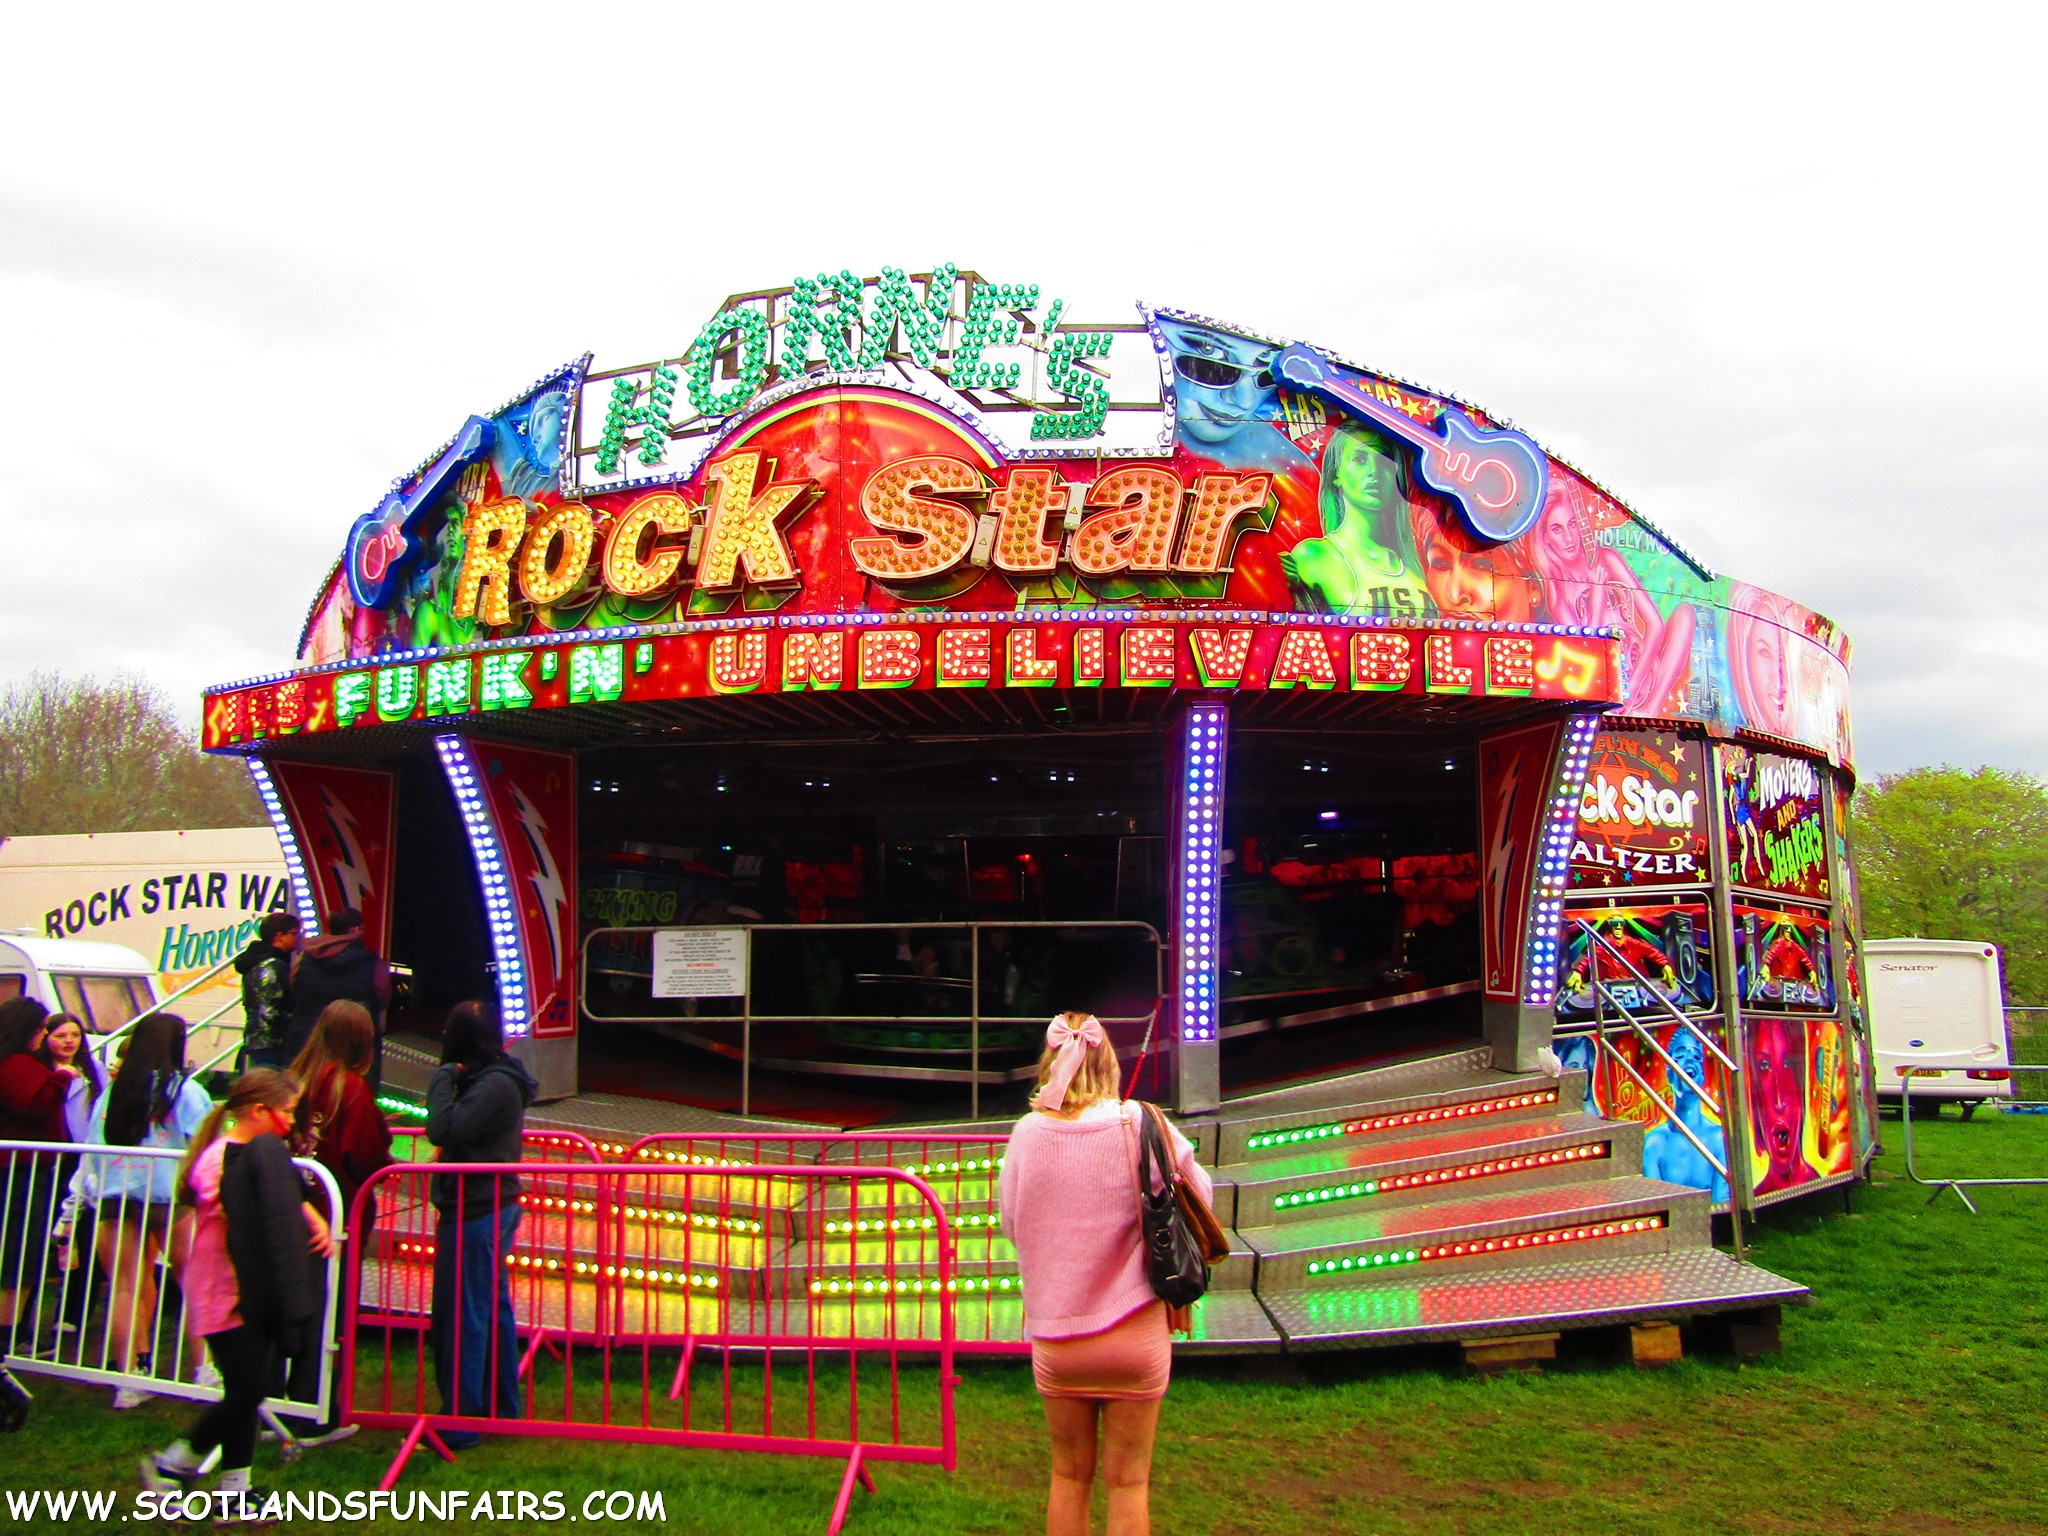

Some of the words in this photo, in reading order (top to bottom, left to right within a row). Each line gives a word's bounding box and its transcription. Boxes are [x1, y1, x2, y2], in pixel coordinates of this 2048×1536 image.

[594, 262, 1114, 475] HORNE'S
[1277, 387, 1327, 441] LAS
[850, 453, 1275, 579] Star
[1368, 586, 1440, 619] USA
[709, 627, 1533, 696] UNBELIEVABLE
[1621, 776, 1699, 827] Star
[1759, 758, 1812, 811] MOVERS
[1776, 800, 1797, 831] AND
[1569, 841, 1697, 875] ALTZER
[1765, 812, 1823, 888] SHAKERS
[45, 884, 131, 939] ROCK
[141, 872, 228, 914] STAR
[1879, 963, 1939, 972] Senator
